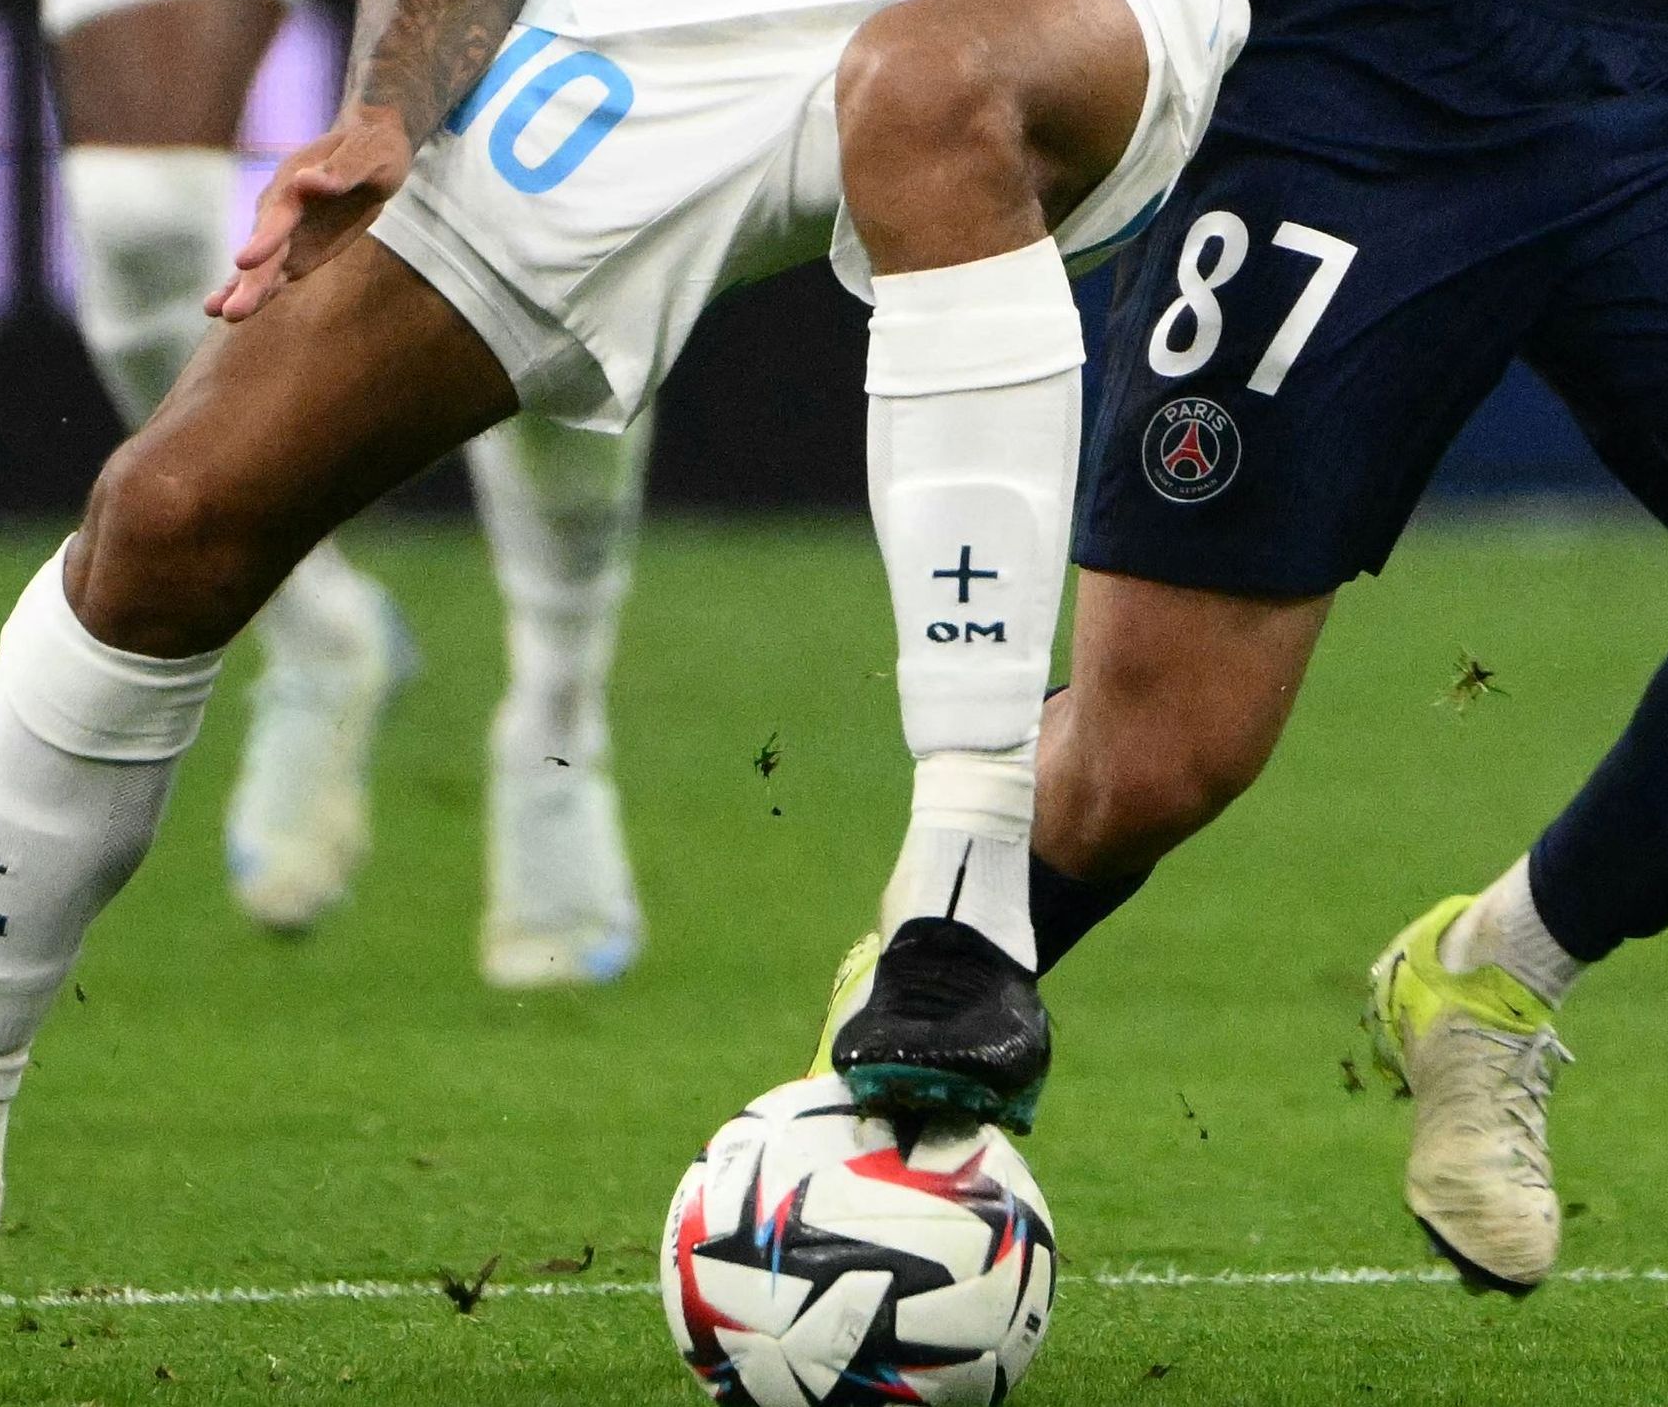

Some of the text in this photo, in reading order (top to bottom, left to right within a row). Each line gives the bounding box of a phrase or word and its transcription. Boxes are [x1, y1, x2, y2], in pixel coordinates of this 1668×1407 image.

[442, 26, 636, 196] 10
[1147, 209, 1359, 397] 87
[1164, 402, 1228, 433] PARIS
[926, 620, 1008, 644] OM
